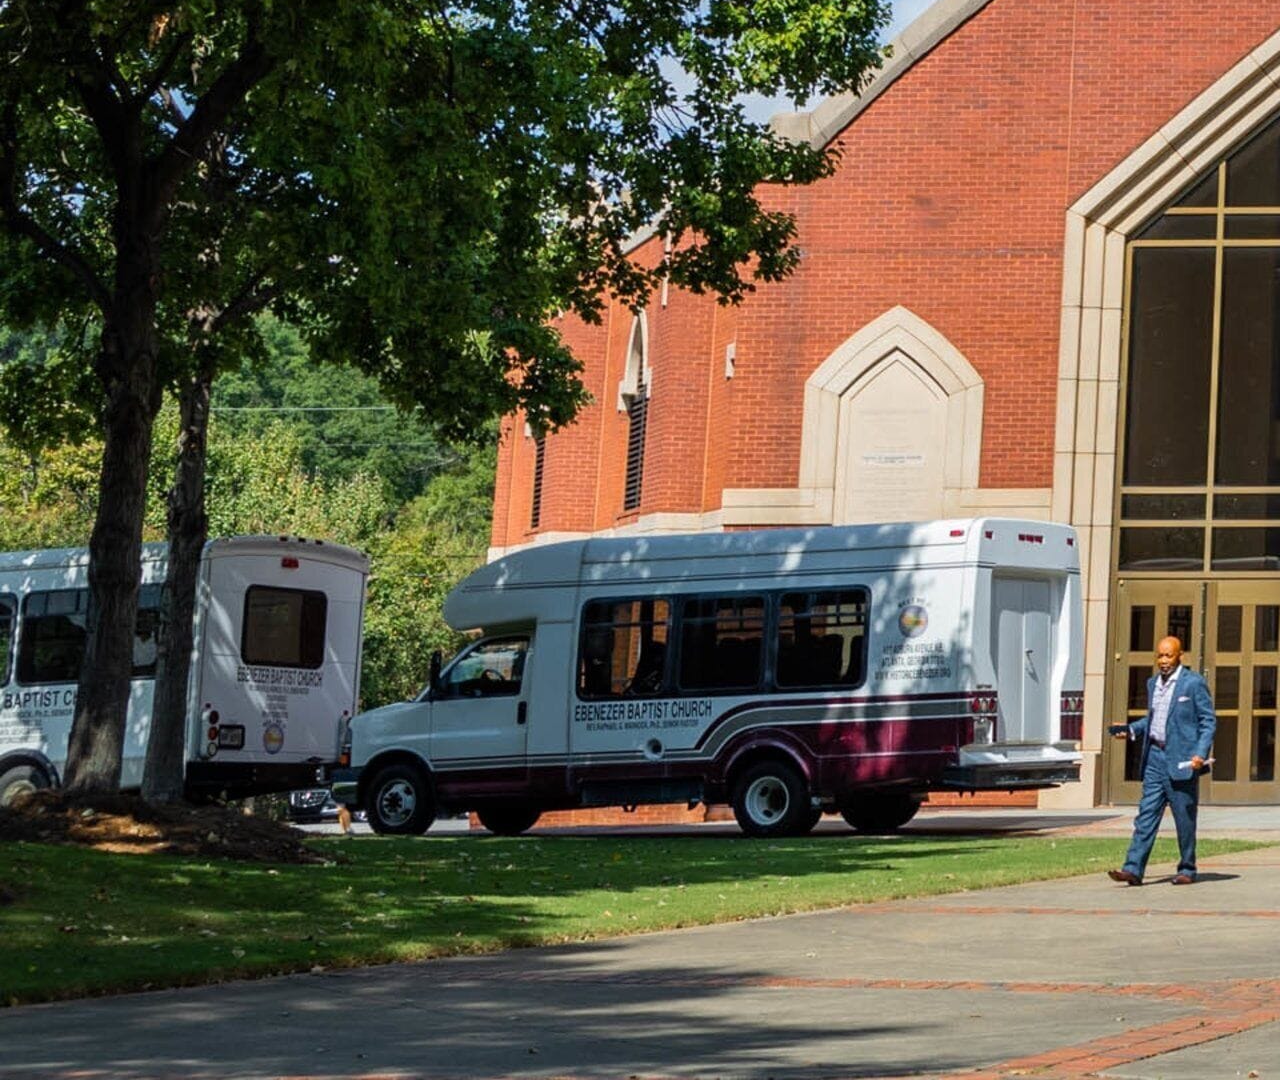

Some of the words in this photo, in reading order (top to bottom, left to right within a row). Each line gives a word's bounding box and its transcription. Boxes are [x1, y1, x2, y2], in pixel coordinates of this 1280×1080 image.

[271, 668, 297, 686] BAPTIST
[298, 670, 322, 688] CHURCH
[4, 690, 60, 709] BAPTIST
[575, 704, 625, 721] EBENEZER
[627, 701, 670, 720] BAPTIST
[671, 699, 712, 718] CHURCH
